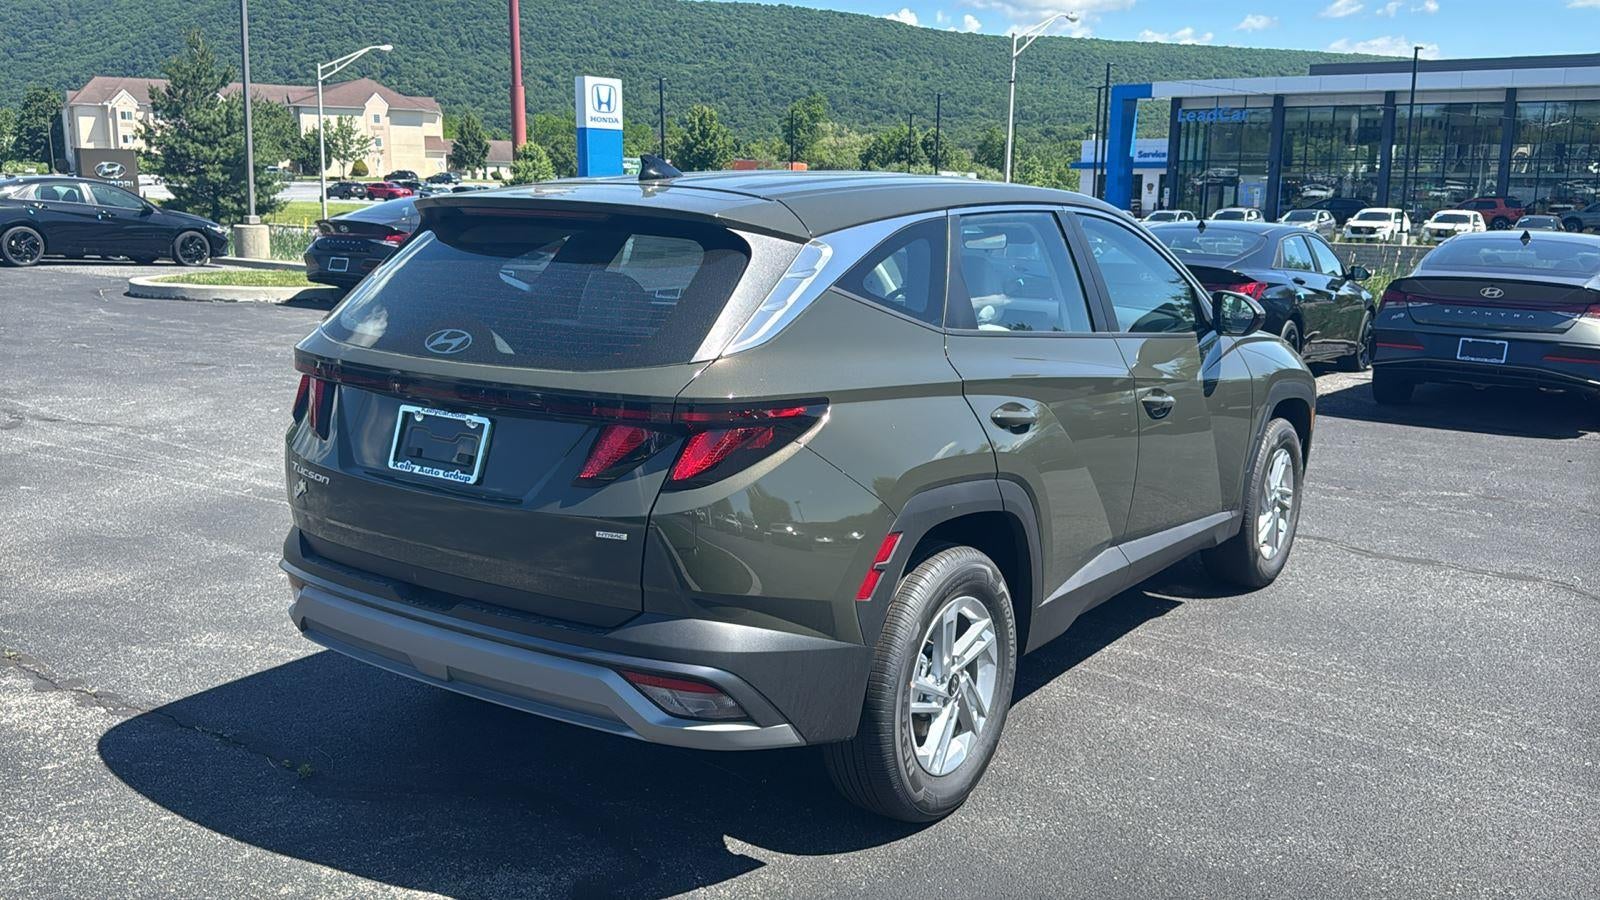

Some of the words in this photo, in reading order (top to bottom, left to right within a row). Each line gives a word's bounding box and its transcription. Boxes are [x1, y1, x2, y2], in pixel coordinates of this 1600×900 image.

[590, 116, 620, 125] HONDA
[1137, 150, 1167, 158] Service
[392, 460, 416, 472] Kelly
[418, 466, 440, 476] Auto
[442, 471, 471, 482] Group
